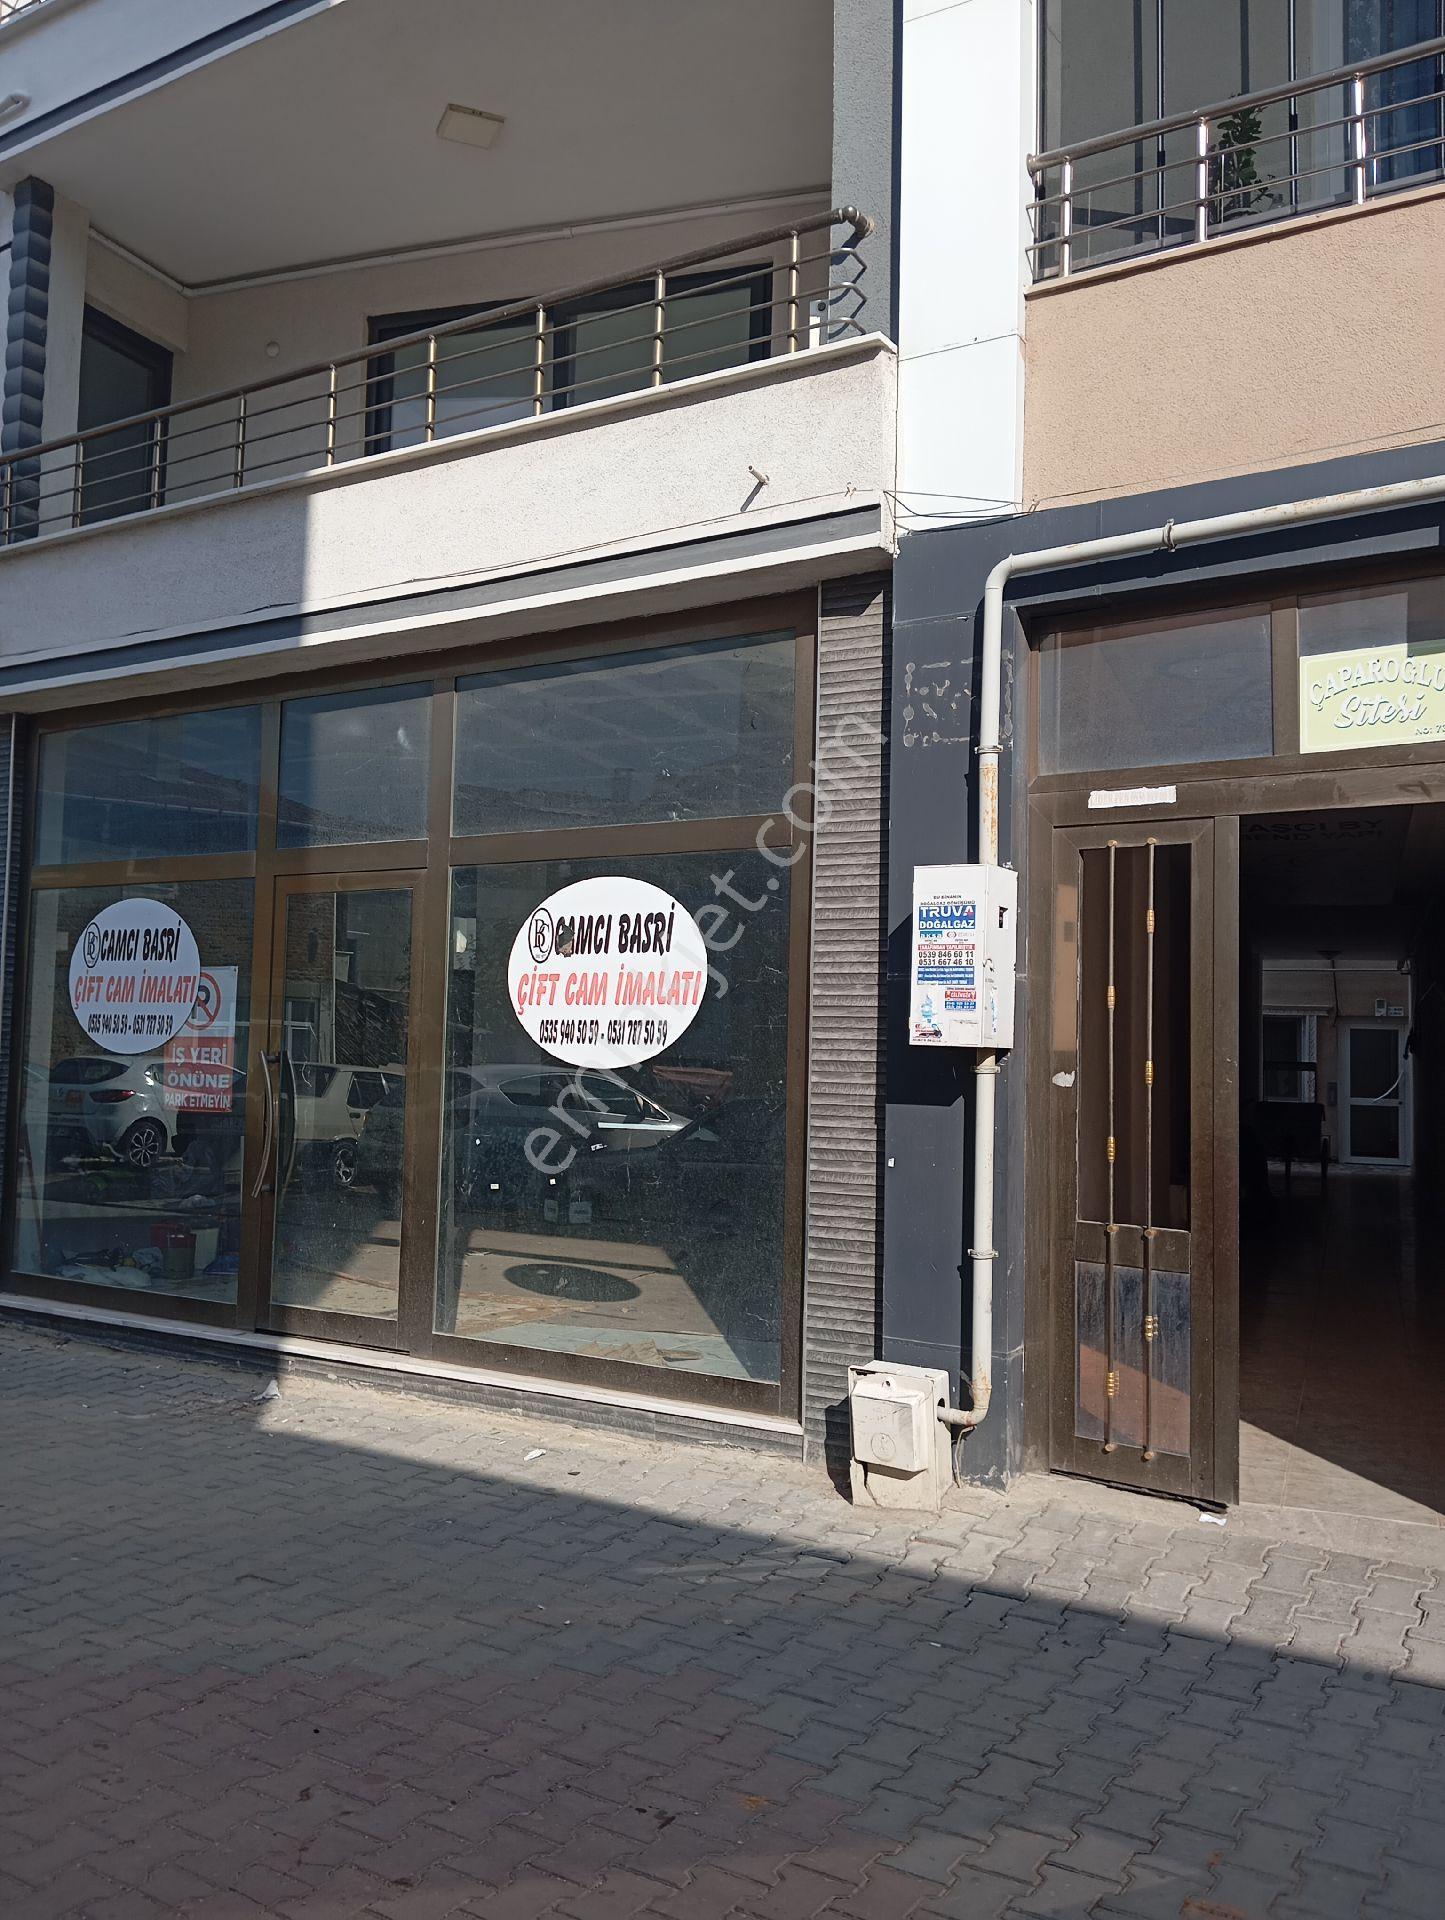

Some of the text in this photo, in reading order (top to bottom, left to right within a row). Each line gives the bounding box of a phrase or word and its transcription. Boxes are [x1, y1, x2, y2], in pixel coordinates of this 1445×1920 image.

[1334, 692, 1428, 728] Sitesi
[920, 905, 974, 918] TRUVA
[920, 919, 974, 928] DOĞALGAZ
[101, 928, 140, 961] CAMCI
[142, 920, 181, 963] BASRİ
[618, 902, 676, 956] BASRİ
[74, 968, 197, 1010] ÇİFT CAM İMALATI
[517, 964, 702, 1015] ÇİFT CAM İMALATI
[540, 1019, 558, 1044] 0535
[560, 1019, 575, 1046] 940
[576, 1020, 587, 1044] 50
[588, 1020, 599, 1046] 59
[607, 1020, 626, 1045] 0531
[644, 1020, 655, 1045] 50
[656, 1020, 668, 1046] 59
[172, 1043, 227, 1067] İŞ YERİ
[168, 1070, 230, 1089] ÖNÜNE
[164, 1090, 232, 1108] PARK ETMEYİN
